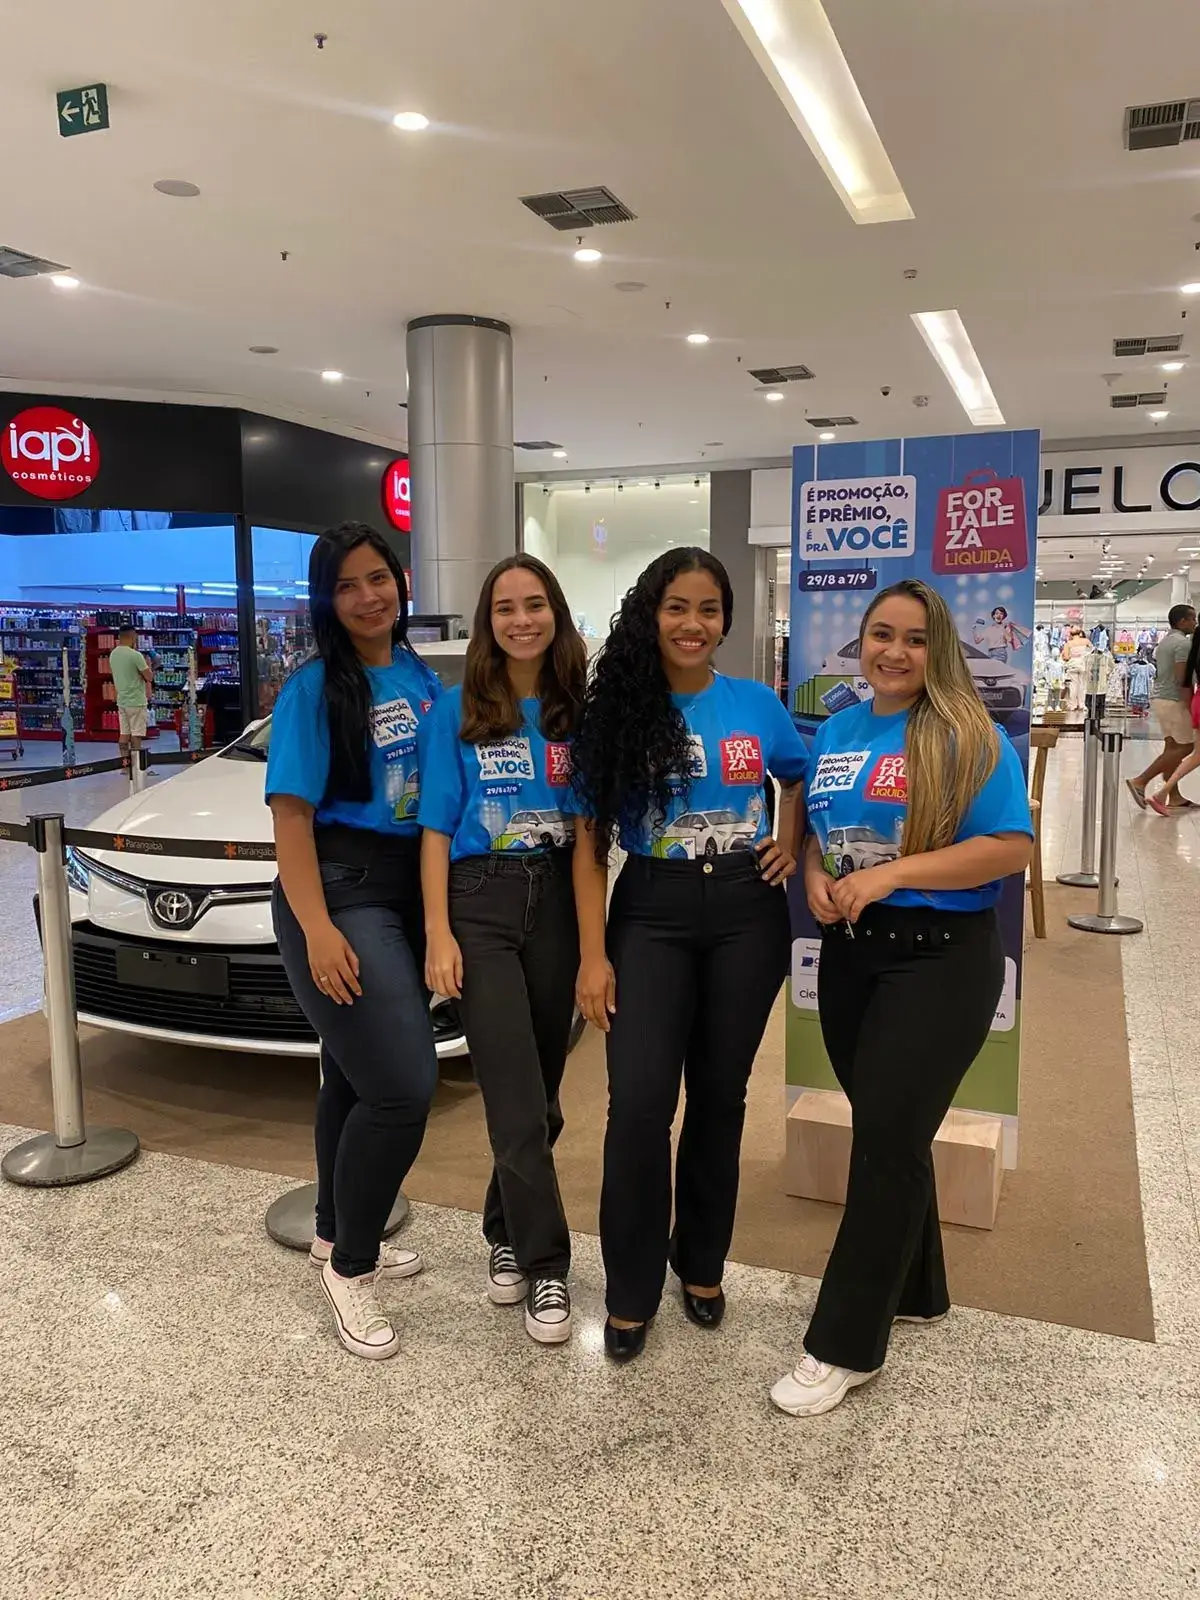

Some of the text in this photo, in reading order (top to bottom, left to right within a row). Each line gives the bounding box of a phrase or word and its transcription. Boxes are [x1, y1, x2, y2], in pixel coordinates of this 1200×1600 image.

[12, 471, 92, 482] cosméticos
[393, 470, 411, 502] ia
[807, 483, 909, 502] É PROMOÇÃO,
[947, 487, 1003, 512] FOR
[806, 503, 891, 523] É PRÊMIO,
[946, 504, 1015, 530] TALE
[806, 529, 813, 540] É
[806, 518, 908, 552] PRA VOCÊ
[945, 528, 983, 550] ZA
[944, 548, 1013, 566] LIQUIDA
[807, 573, 868, 586] 29/8 a 7/9
[725, 740, 753, 751] FOR
[727, 749, 760, 760] TALE
[729, 759, 748, 771] ZA
[881, 757, 906, 767] FO
[879, 766, 907, 777] TAL
[816, 771, 855, 791] VOCÊ
[873, 776, 896, 787] ZA
[126, 839, 163, 852] Parangaba
[799, 988, 817, 999] cie
